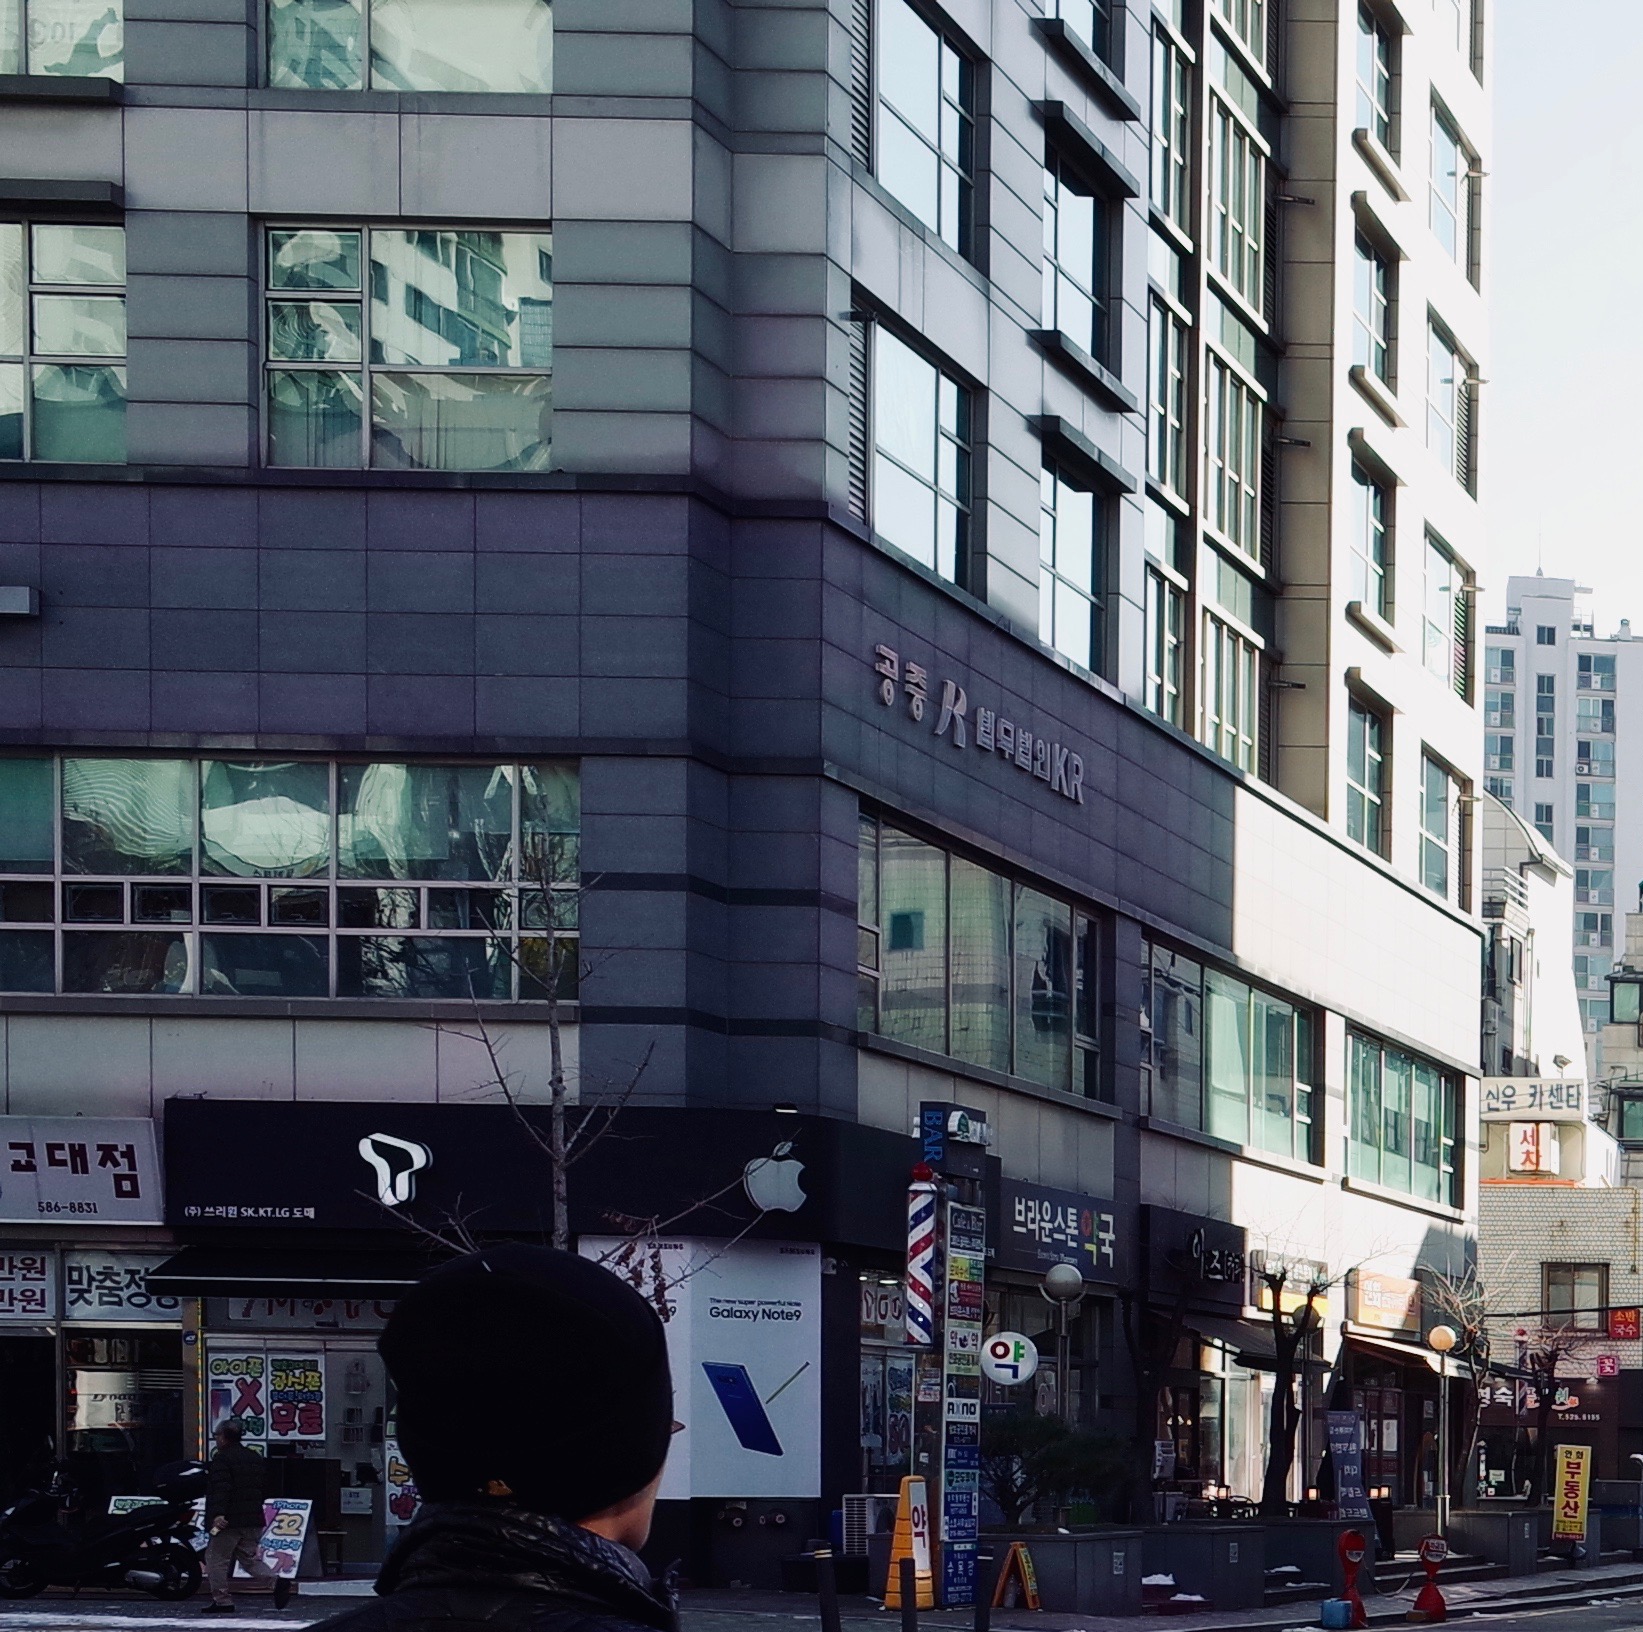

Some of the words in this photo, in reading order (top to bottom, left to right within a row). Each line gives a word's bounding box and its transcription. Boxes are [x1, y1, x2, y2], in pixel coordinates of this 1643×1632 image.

[875, 643, 928, 722] 공증
[923, 1110, 945, 1162] BAR
[1519, 1127, 1543, 1167] 세차
[8, 1141, 141, 1199] 교대점
[37, 1201, 99, 1215] 586-8831
[709, 1306, 760, 1323] Galaxy
[761, 1307, 802, 1322] Note9
[210, 1355, 265, 1378] 아이폰
[990, 1340, 1026, 1379] 약
[232, 1378, 265, 1416] X
[270, 1401, 324, 1437] 무료
[911, 1503, 928, 1549] 약
